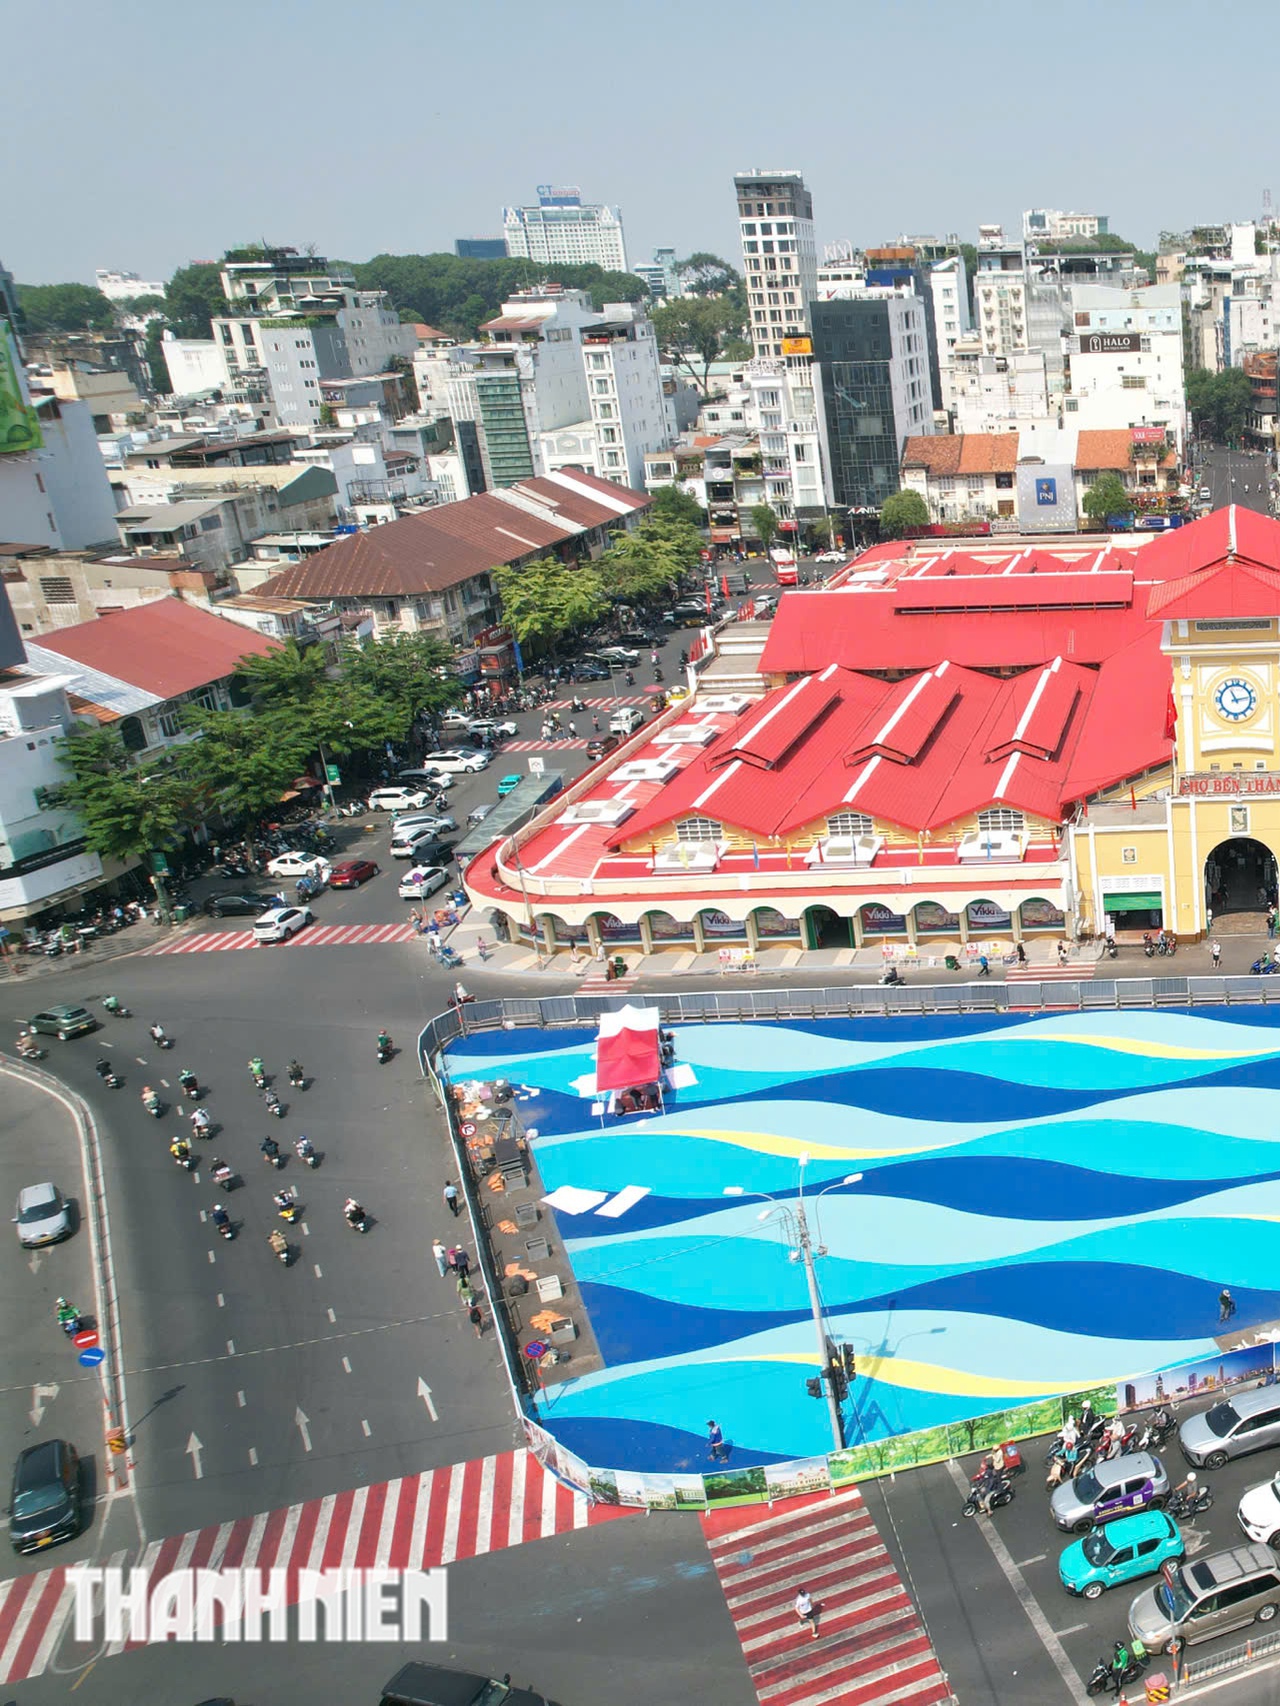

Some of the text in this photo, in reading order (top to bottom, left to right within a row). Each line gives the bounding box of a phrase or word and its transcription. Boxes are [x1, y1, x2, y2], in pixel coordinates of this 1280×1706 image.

[1103, 338, 1131, 346] HALO
[1039, 492, 1054, 500] PNJ
[1180, 778, 1209, 793] CHỢ
[1213, 776, 1240, 792] BẾN
[971, 904, 995, 916] Vikki
